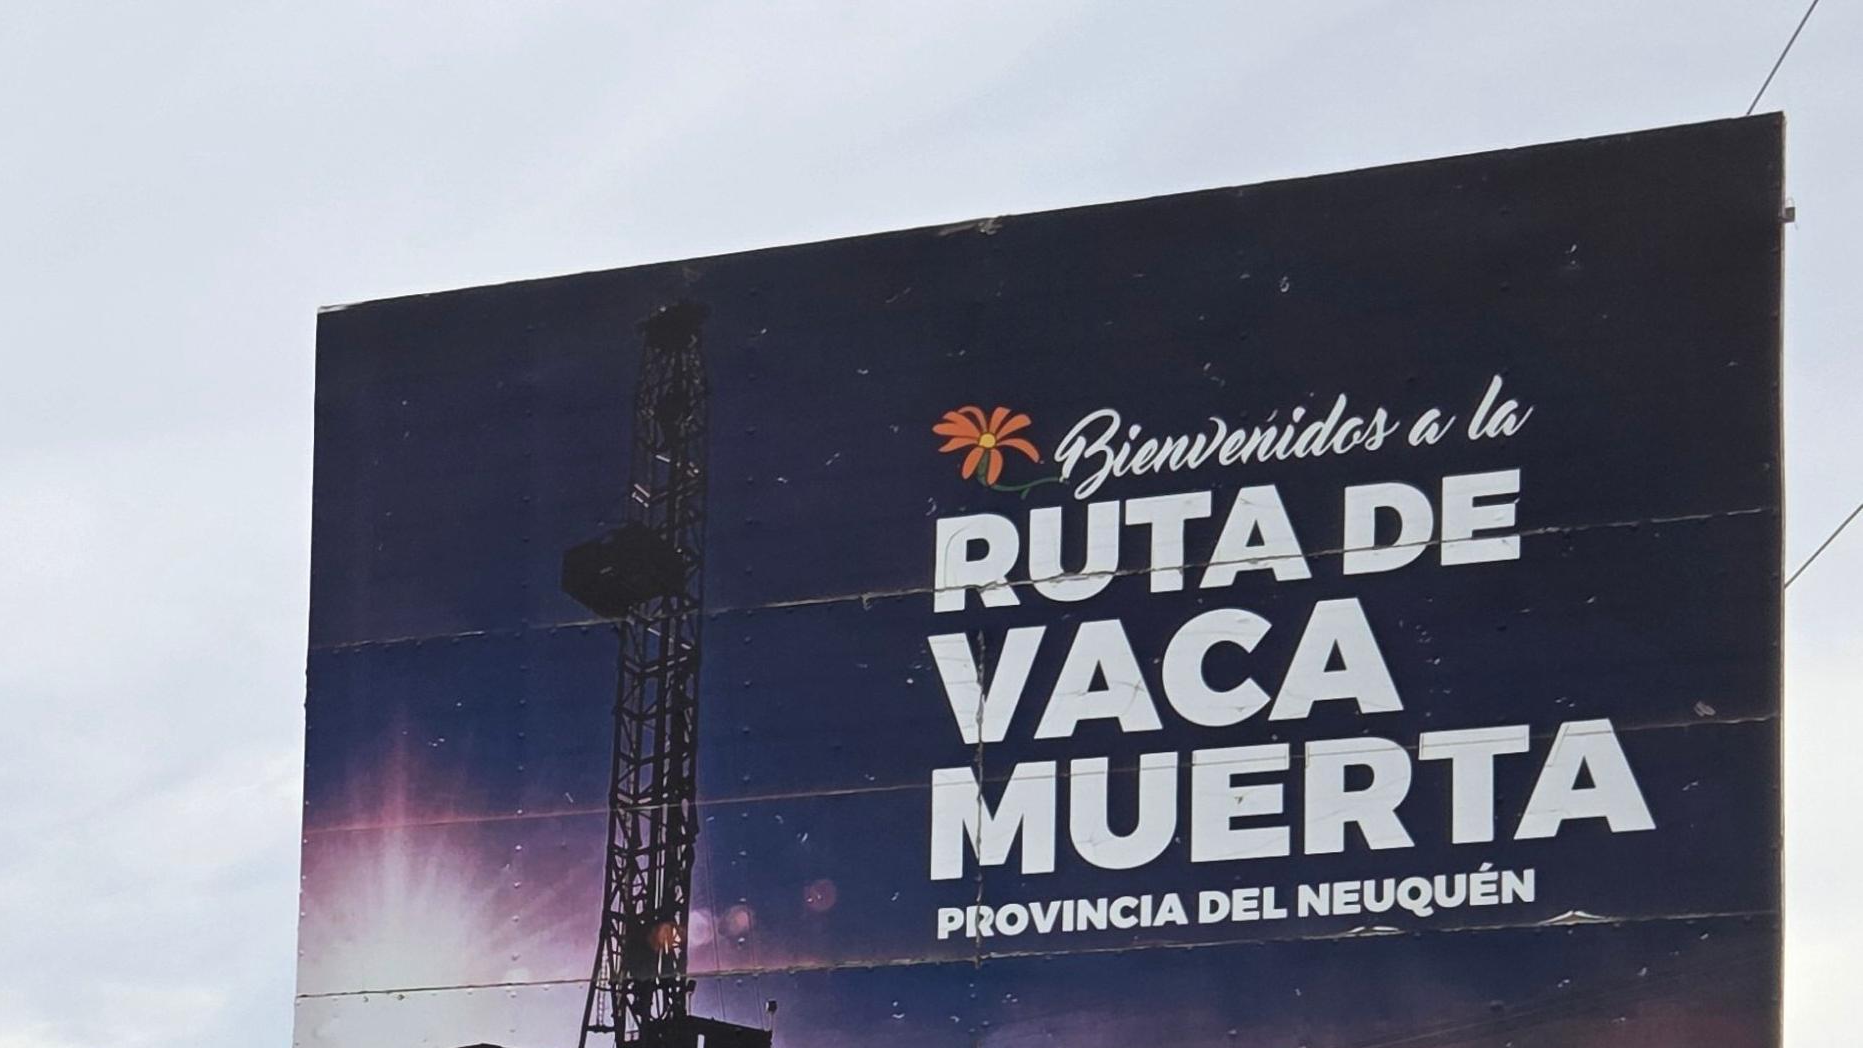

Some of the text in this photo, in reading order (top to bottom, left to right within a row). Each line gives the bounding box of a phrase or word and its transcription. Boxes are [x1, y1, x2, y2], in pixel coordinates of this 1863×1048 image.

[1054, 375, 1533, 501] Bienvenidos a la
[933, 468, 1520, 613] RUTA DE
[928, 597, 1404, 744] VACA
[930, 718, 1657, 880] MUERTA
[937, 863, 1536, 940] PROVINCIA DEL NEUQUÉN
